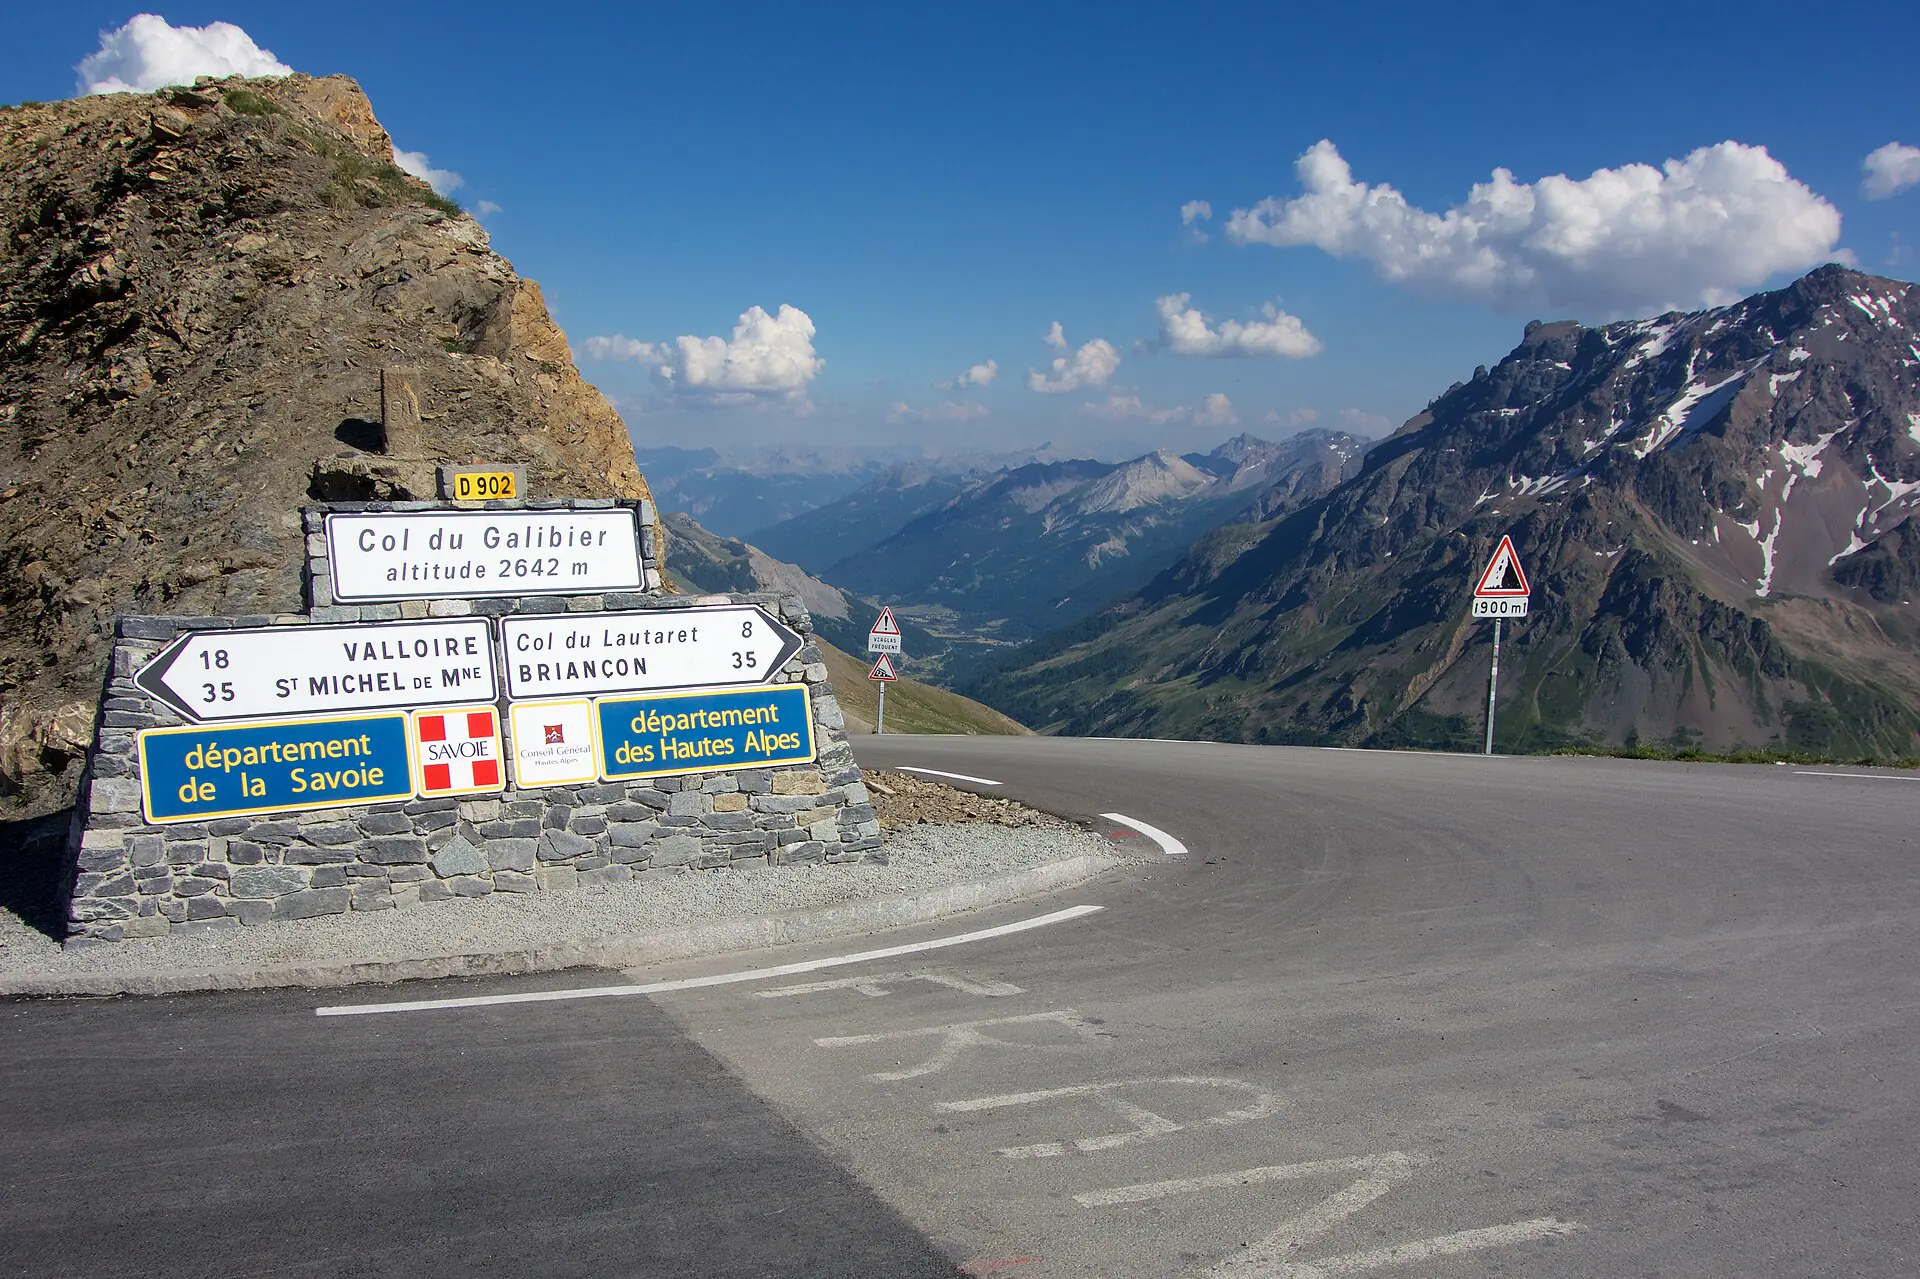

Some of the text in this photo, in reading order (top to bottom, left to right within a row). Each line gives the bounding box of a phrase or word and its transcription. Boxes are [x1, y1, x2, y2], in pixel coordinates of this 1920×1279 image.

[460, 475, 512, 496] D 902
[358, 525, 607, 553] Col du Galibier
[386, 557, 589, 582] altitude 2642 m
[516, 620, 753, 652] Col du Lautaret 8
[199, 636, 478, 670] 18 VALLOIRE
[518, 650, 757, 684] BRIANÇON 35
[202, 682, 235, 703] 35
[308, 671, 406, 697] MICHEL
[413, 676, 433, 690] DE
[631, 703, 780, 738] département
[184, 733, 372, 776] département
[428, 740, 489, 762] SAVOIE
[520, 744, 591, 759] Conseil Général
[615, 729, 801, 766] des Hautes Alpes
[178, 762, 385, 804] de la Savoie
